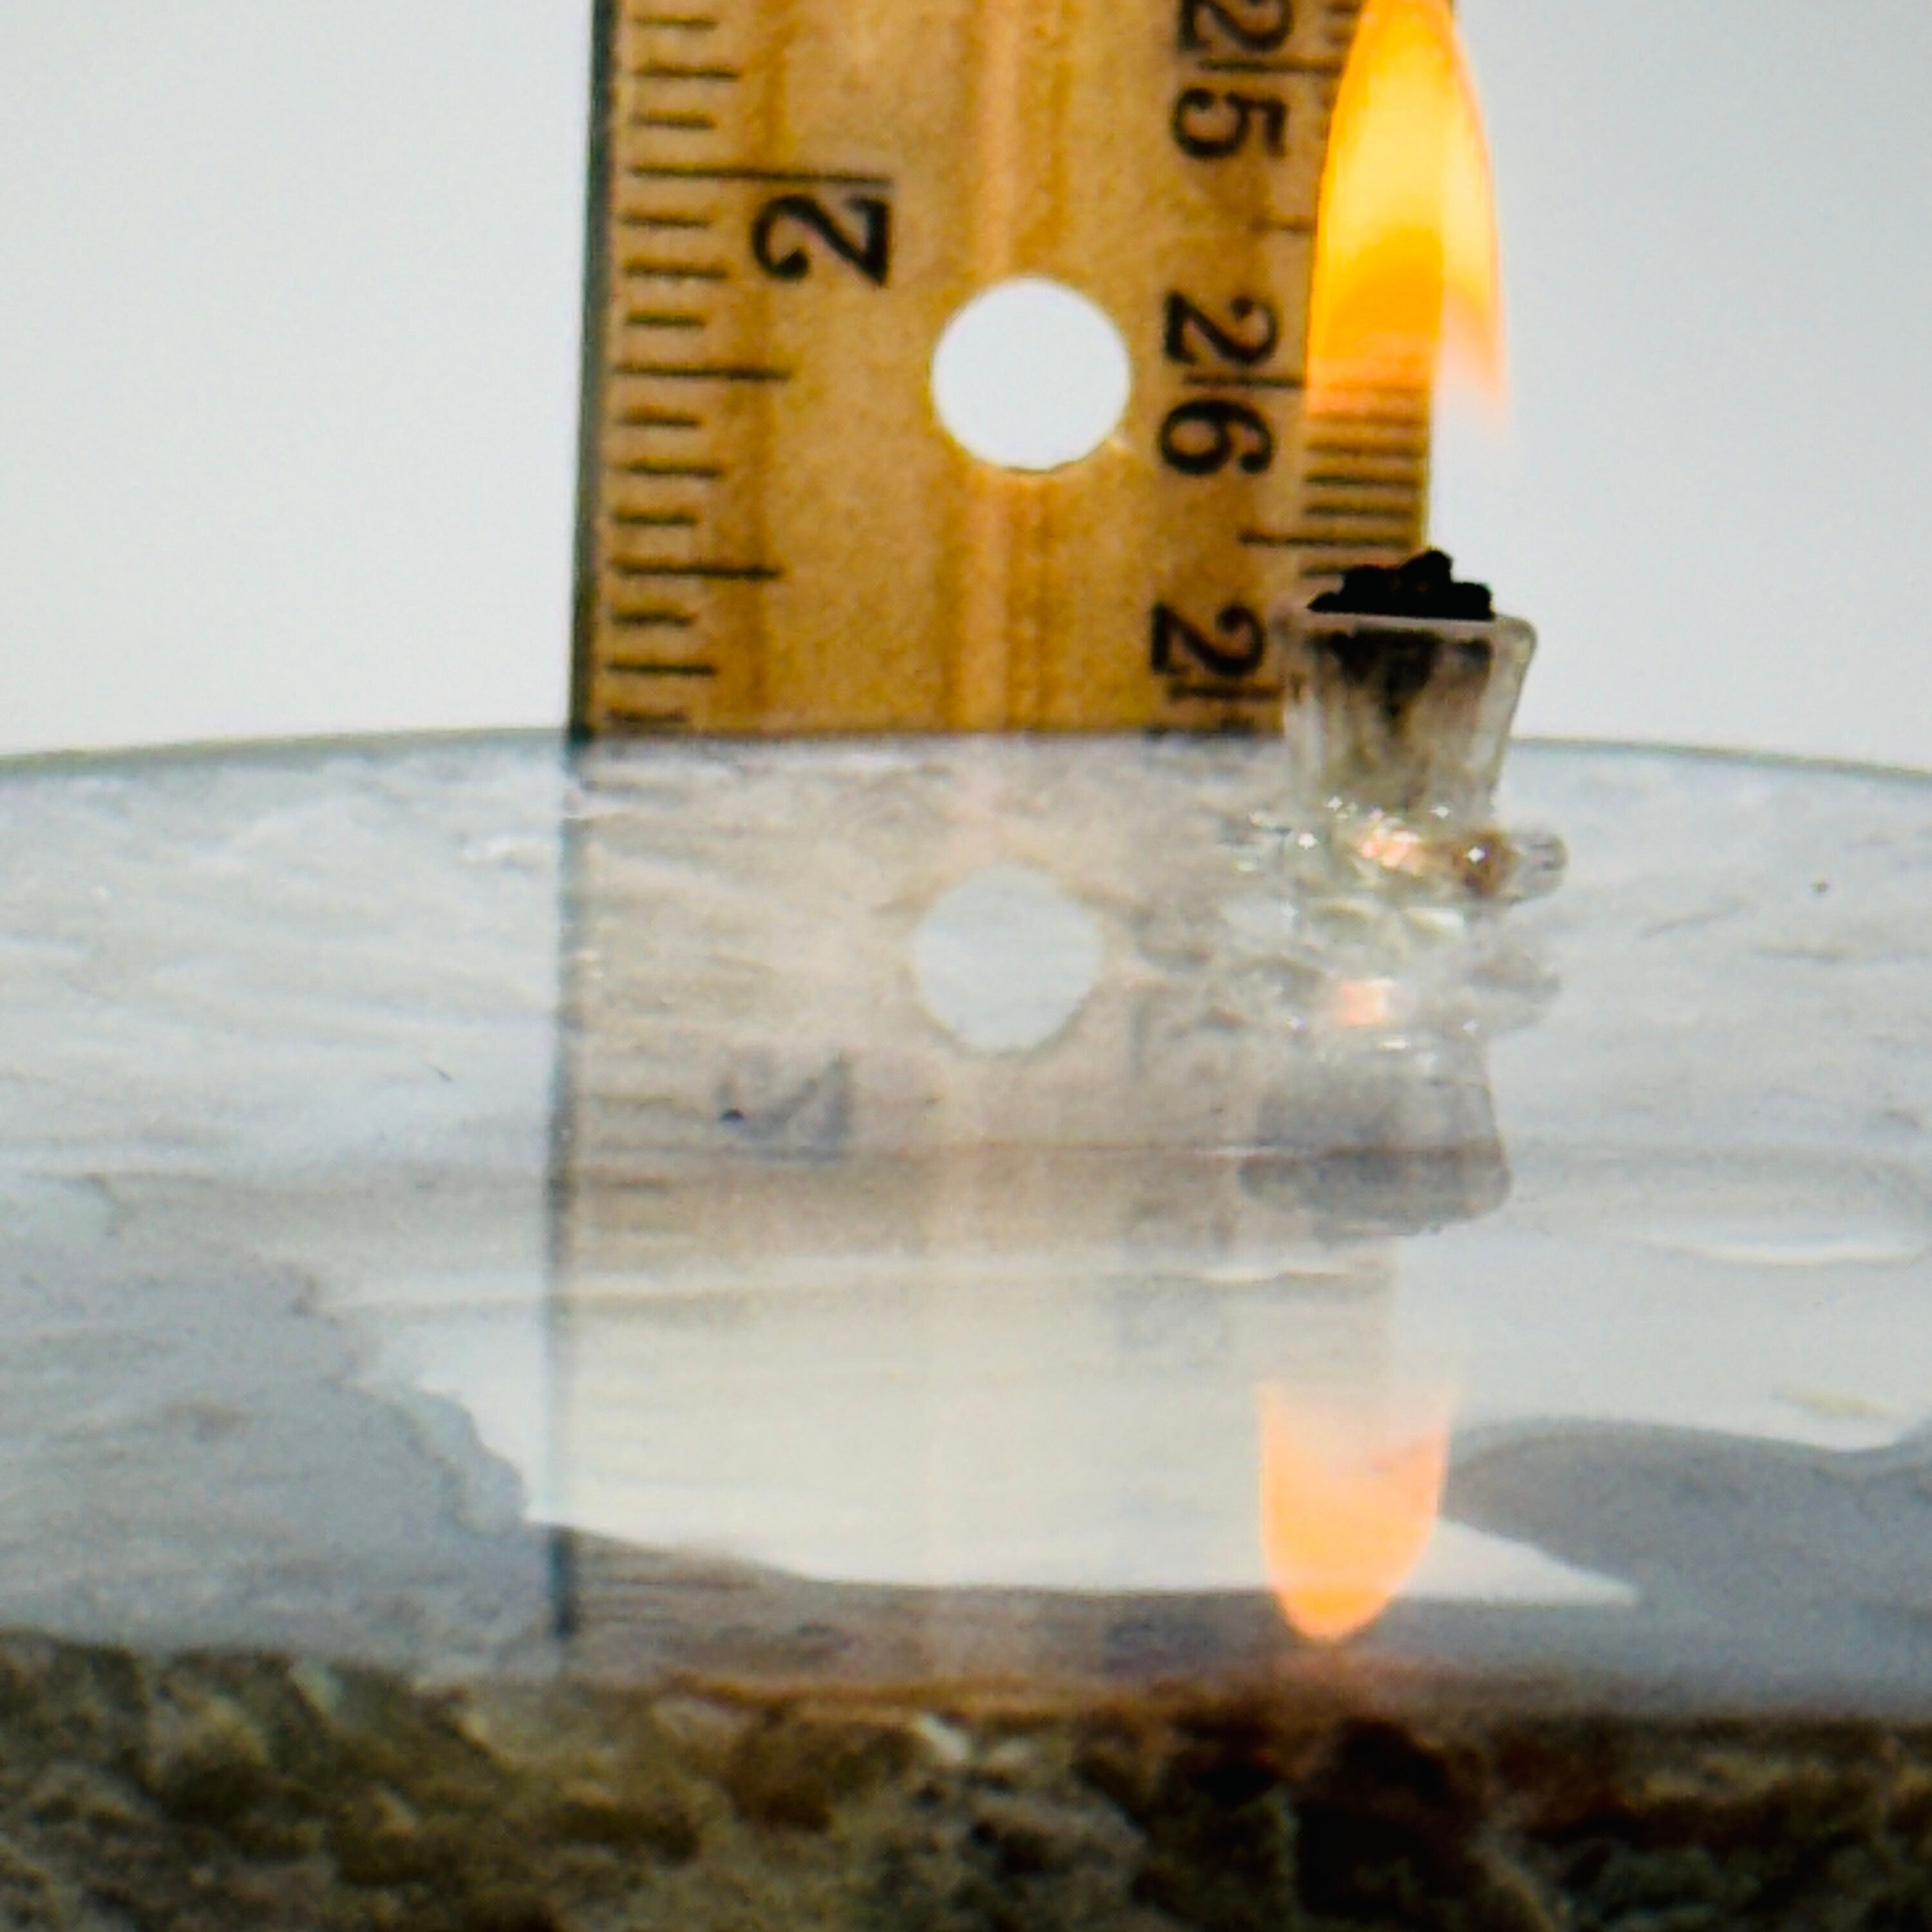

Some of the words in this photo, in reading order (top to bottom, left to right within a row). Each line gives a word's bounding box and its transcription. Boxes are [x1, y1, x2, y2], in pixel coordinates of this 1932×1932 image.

[1168, 0, 1293, 161] 25
[751, 194, 890, 286] 2
[1157, 290, 1278, 476] 26
